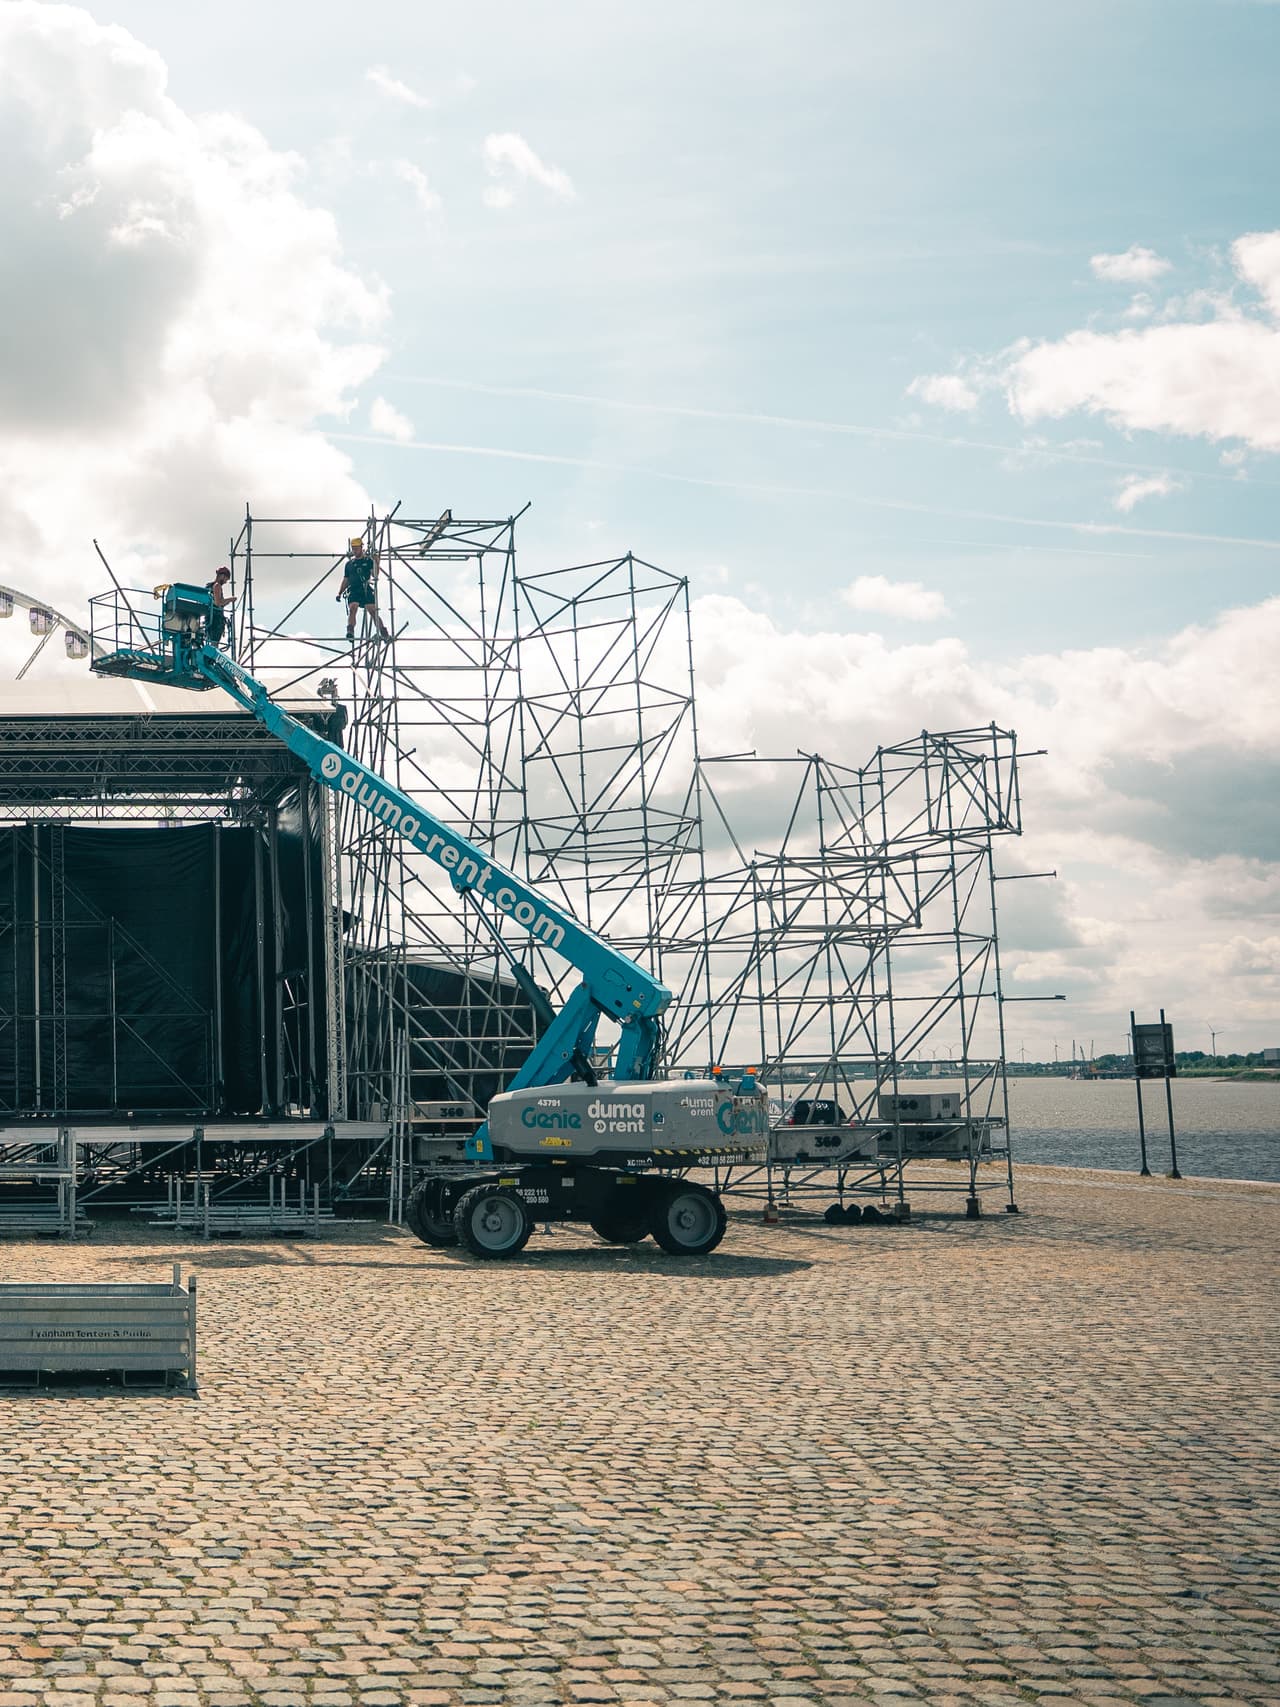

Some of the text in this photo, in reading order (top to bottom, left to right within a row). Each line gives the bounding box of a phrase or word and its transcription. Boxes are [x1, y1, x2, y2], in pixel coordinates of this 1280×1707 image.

[341, 771, 566, 948] duma-rent.com
[680, 1096, 714, 1108] duma
[440, 1107, 465, 1118] 360
[587, 1099, 645, 1119] duma
[521, 1106, 582, 1129] Genie
[609, 1119, 645, 1133] rent
[814, 1135, 842, 1148] 360
[536, 1188, 547, 1196] 111
[76, 1329, 111, 1338] Tenten
